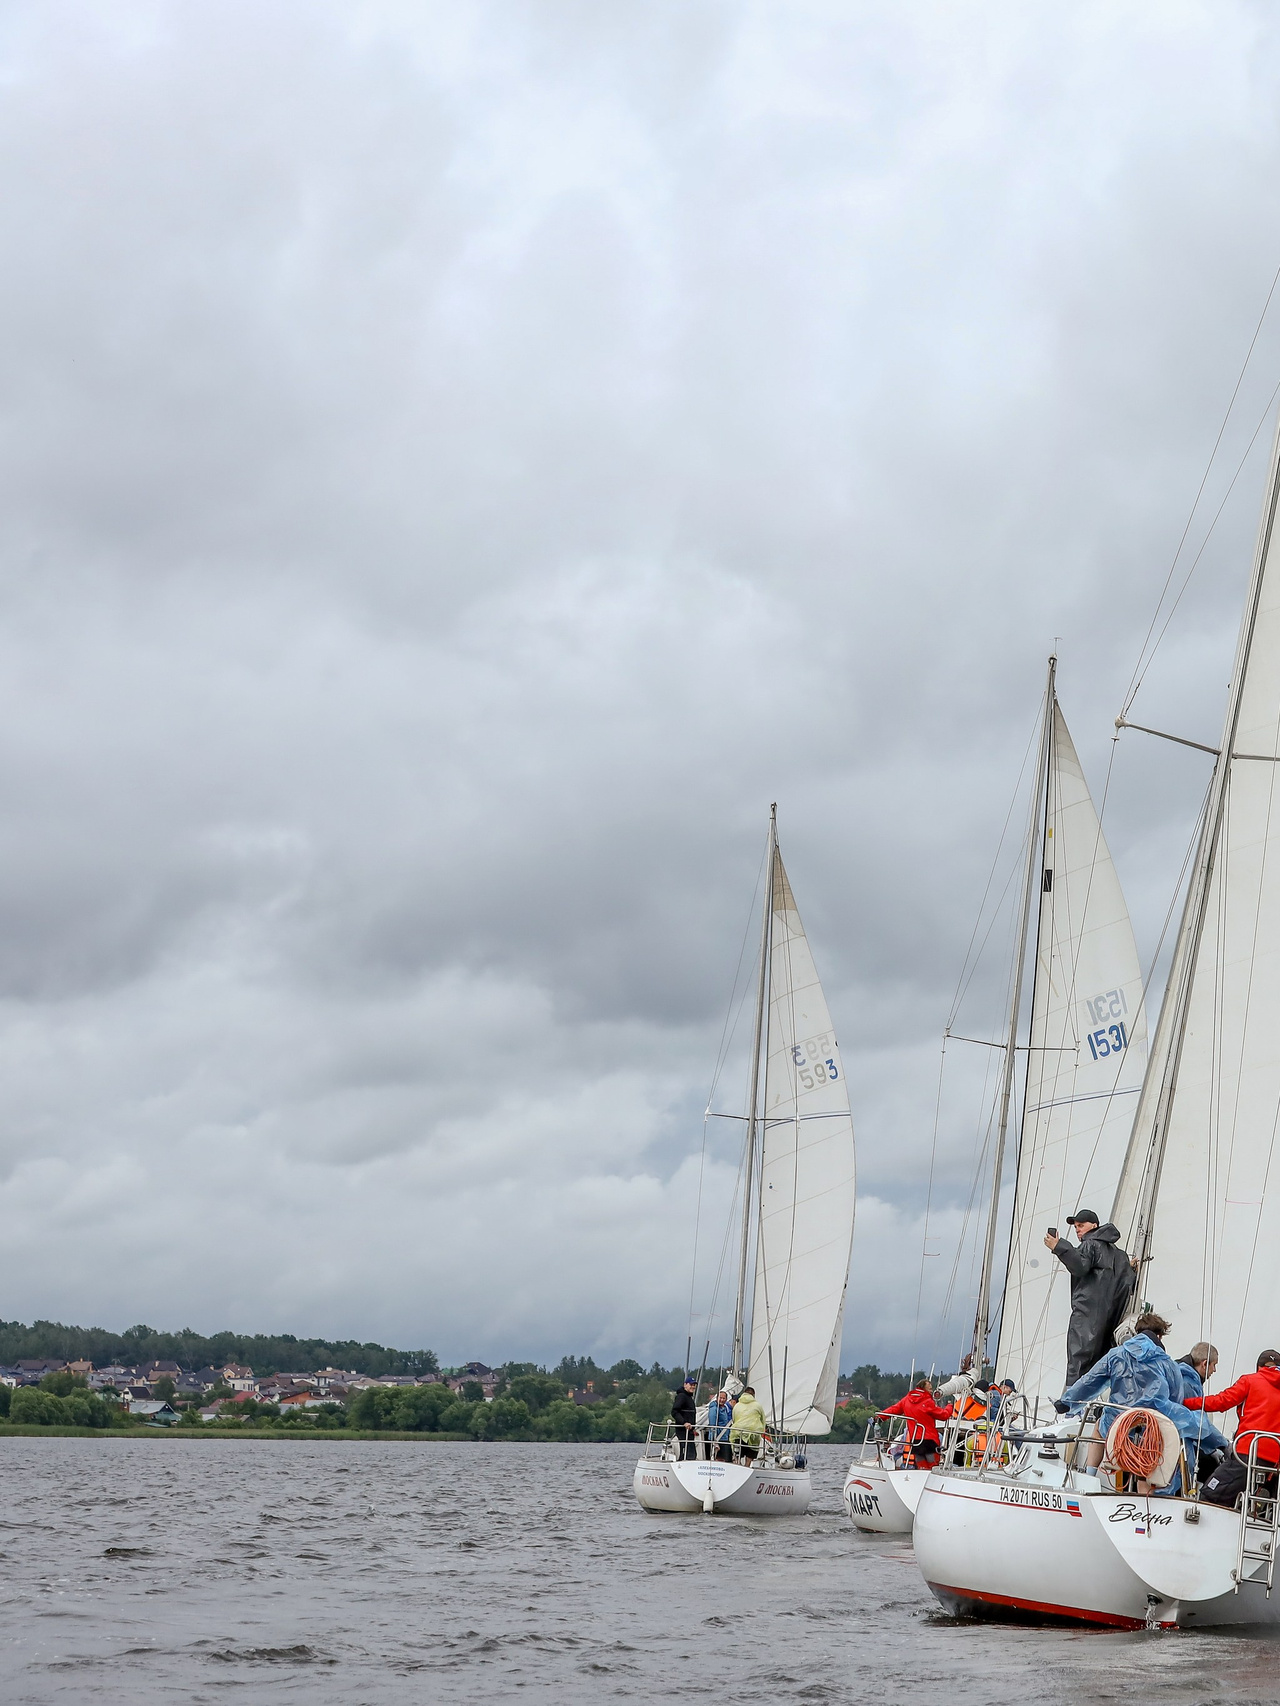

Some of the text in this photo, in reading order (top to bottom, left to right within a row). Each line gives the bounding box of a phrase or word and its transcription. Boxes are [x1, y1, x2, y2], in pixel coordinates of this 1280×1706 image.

[1087, 1022, 1128, 1061] 1531
[798, 1058, 839, 1090] 593
[764, 1484, 794, 1496] МОСКВА
[1000, 1487, 1062, 1509] TA 2071 RUS 50
[846, 1491, 883, 1518] МАРТ
[1108, 1503, 1174, 1526] Весна
